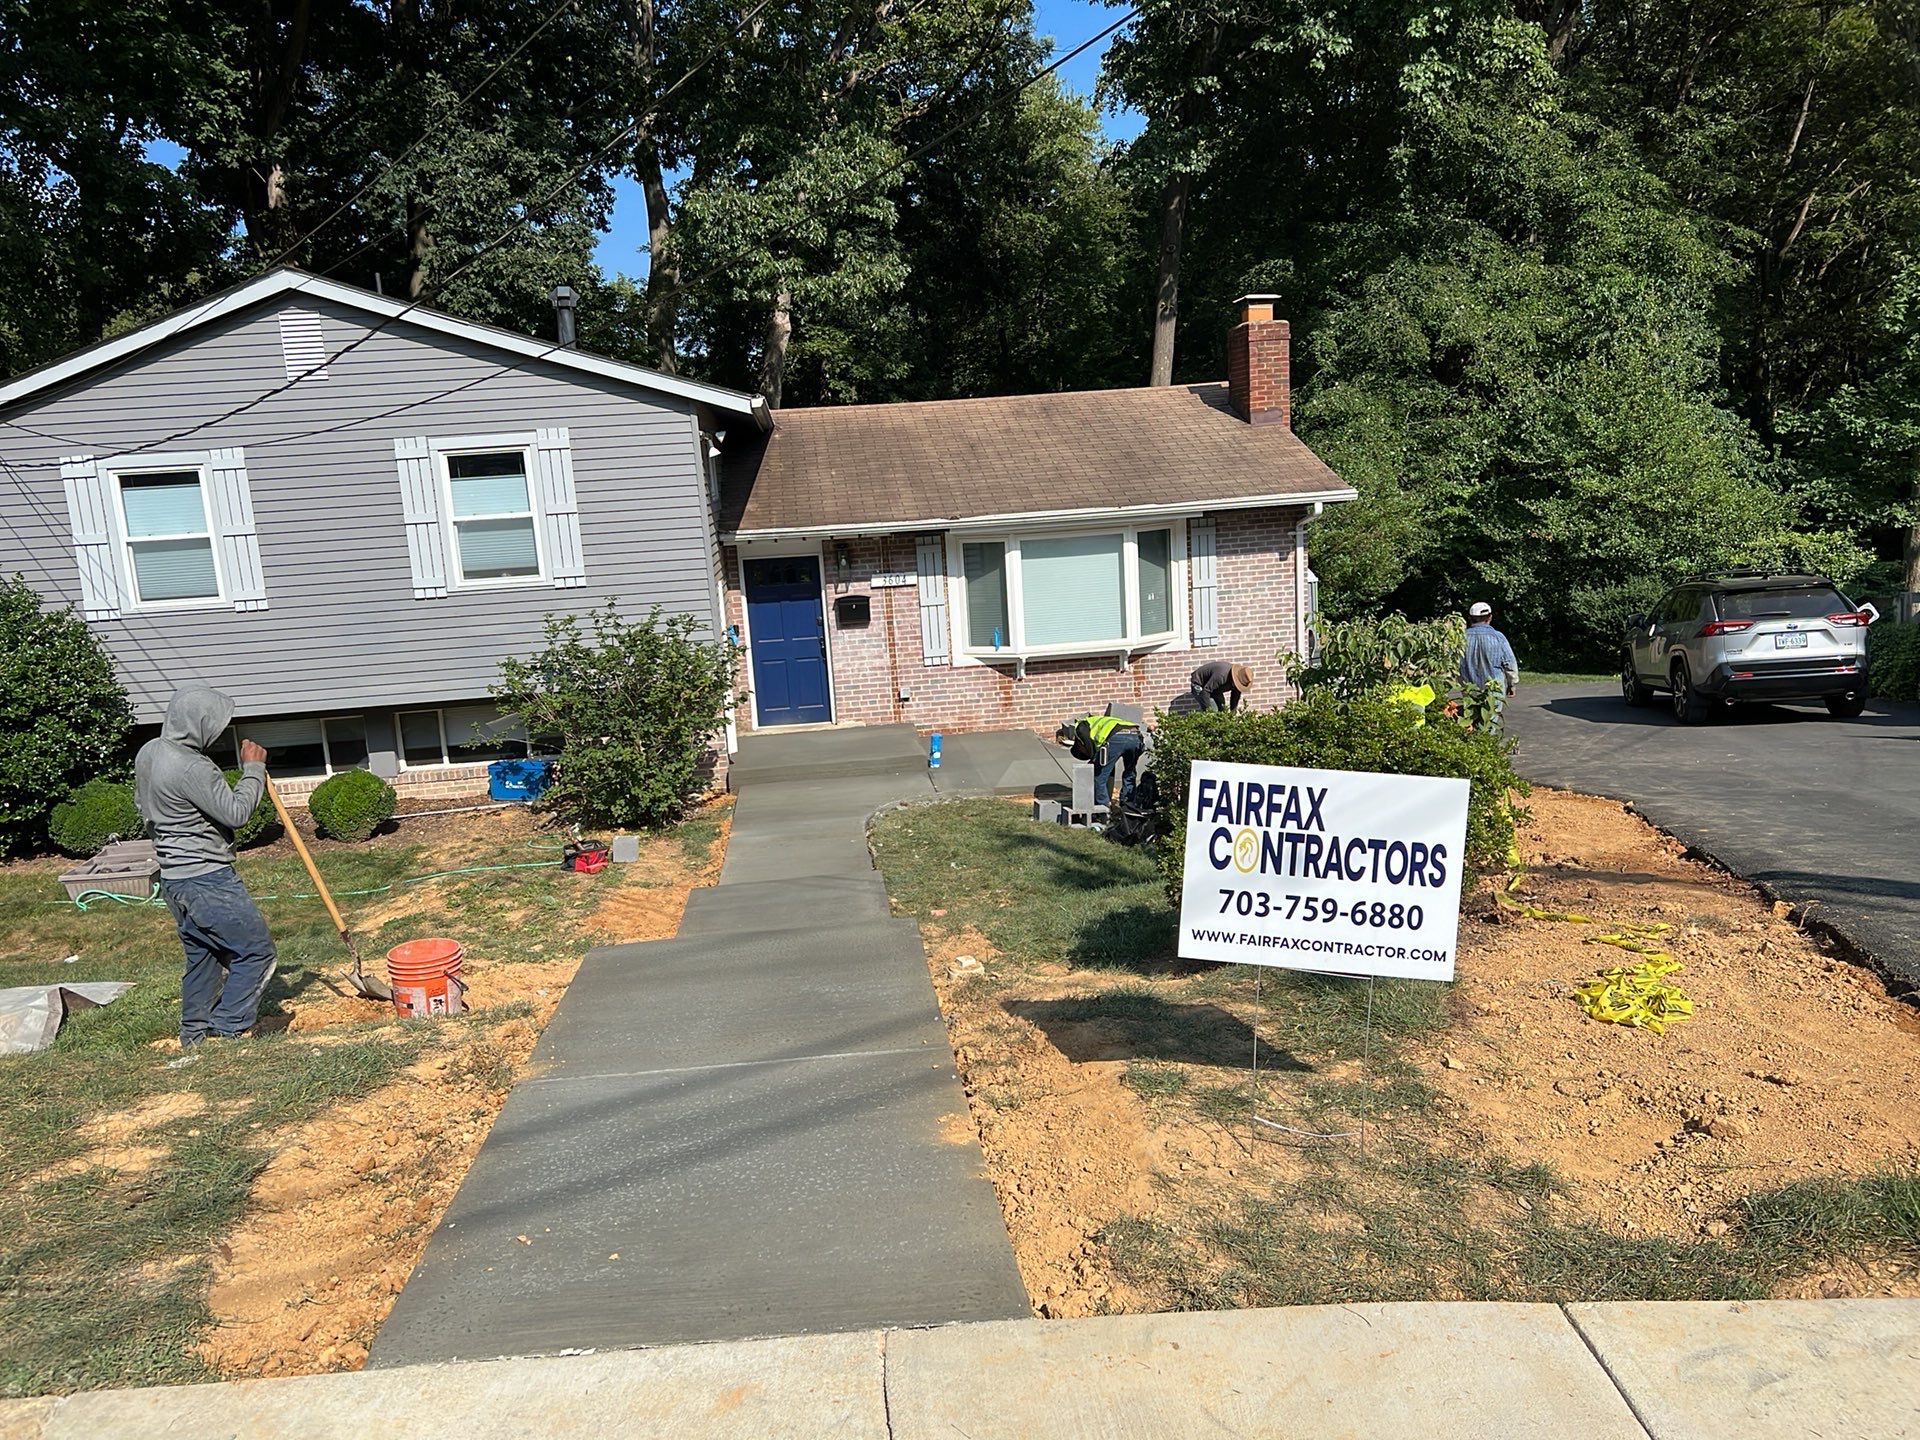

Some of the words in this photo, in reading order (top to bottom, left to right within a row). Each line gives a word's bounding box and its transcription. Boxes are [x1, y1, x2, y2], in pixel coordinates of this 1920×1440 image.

[883, 575, 906, 585] 3604
[1196, 778, 1328, 832] FAIRFAX
[1208, 826, 1447, 888] CONTRACTORS
[1218, 889, 1424, 931] 703-759-6880
[1191, 929, 1447, 962] WWW.FAIRFAXCONTRACTOR.COM
